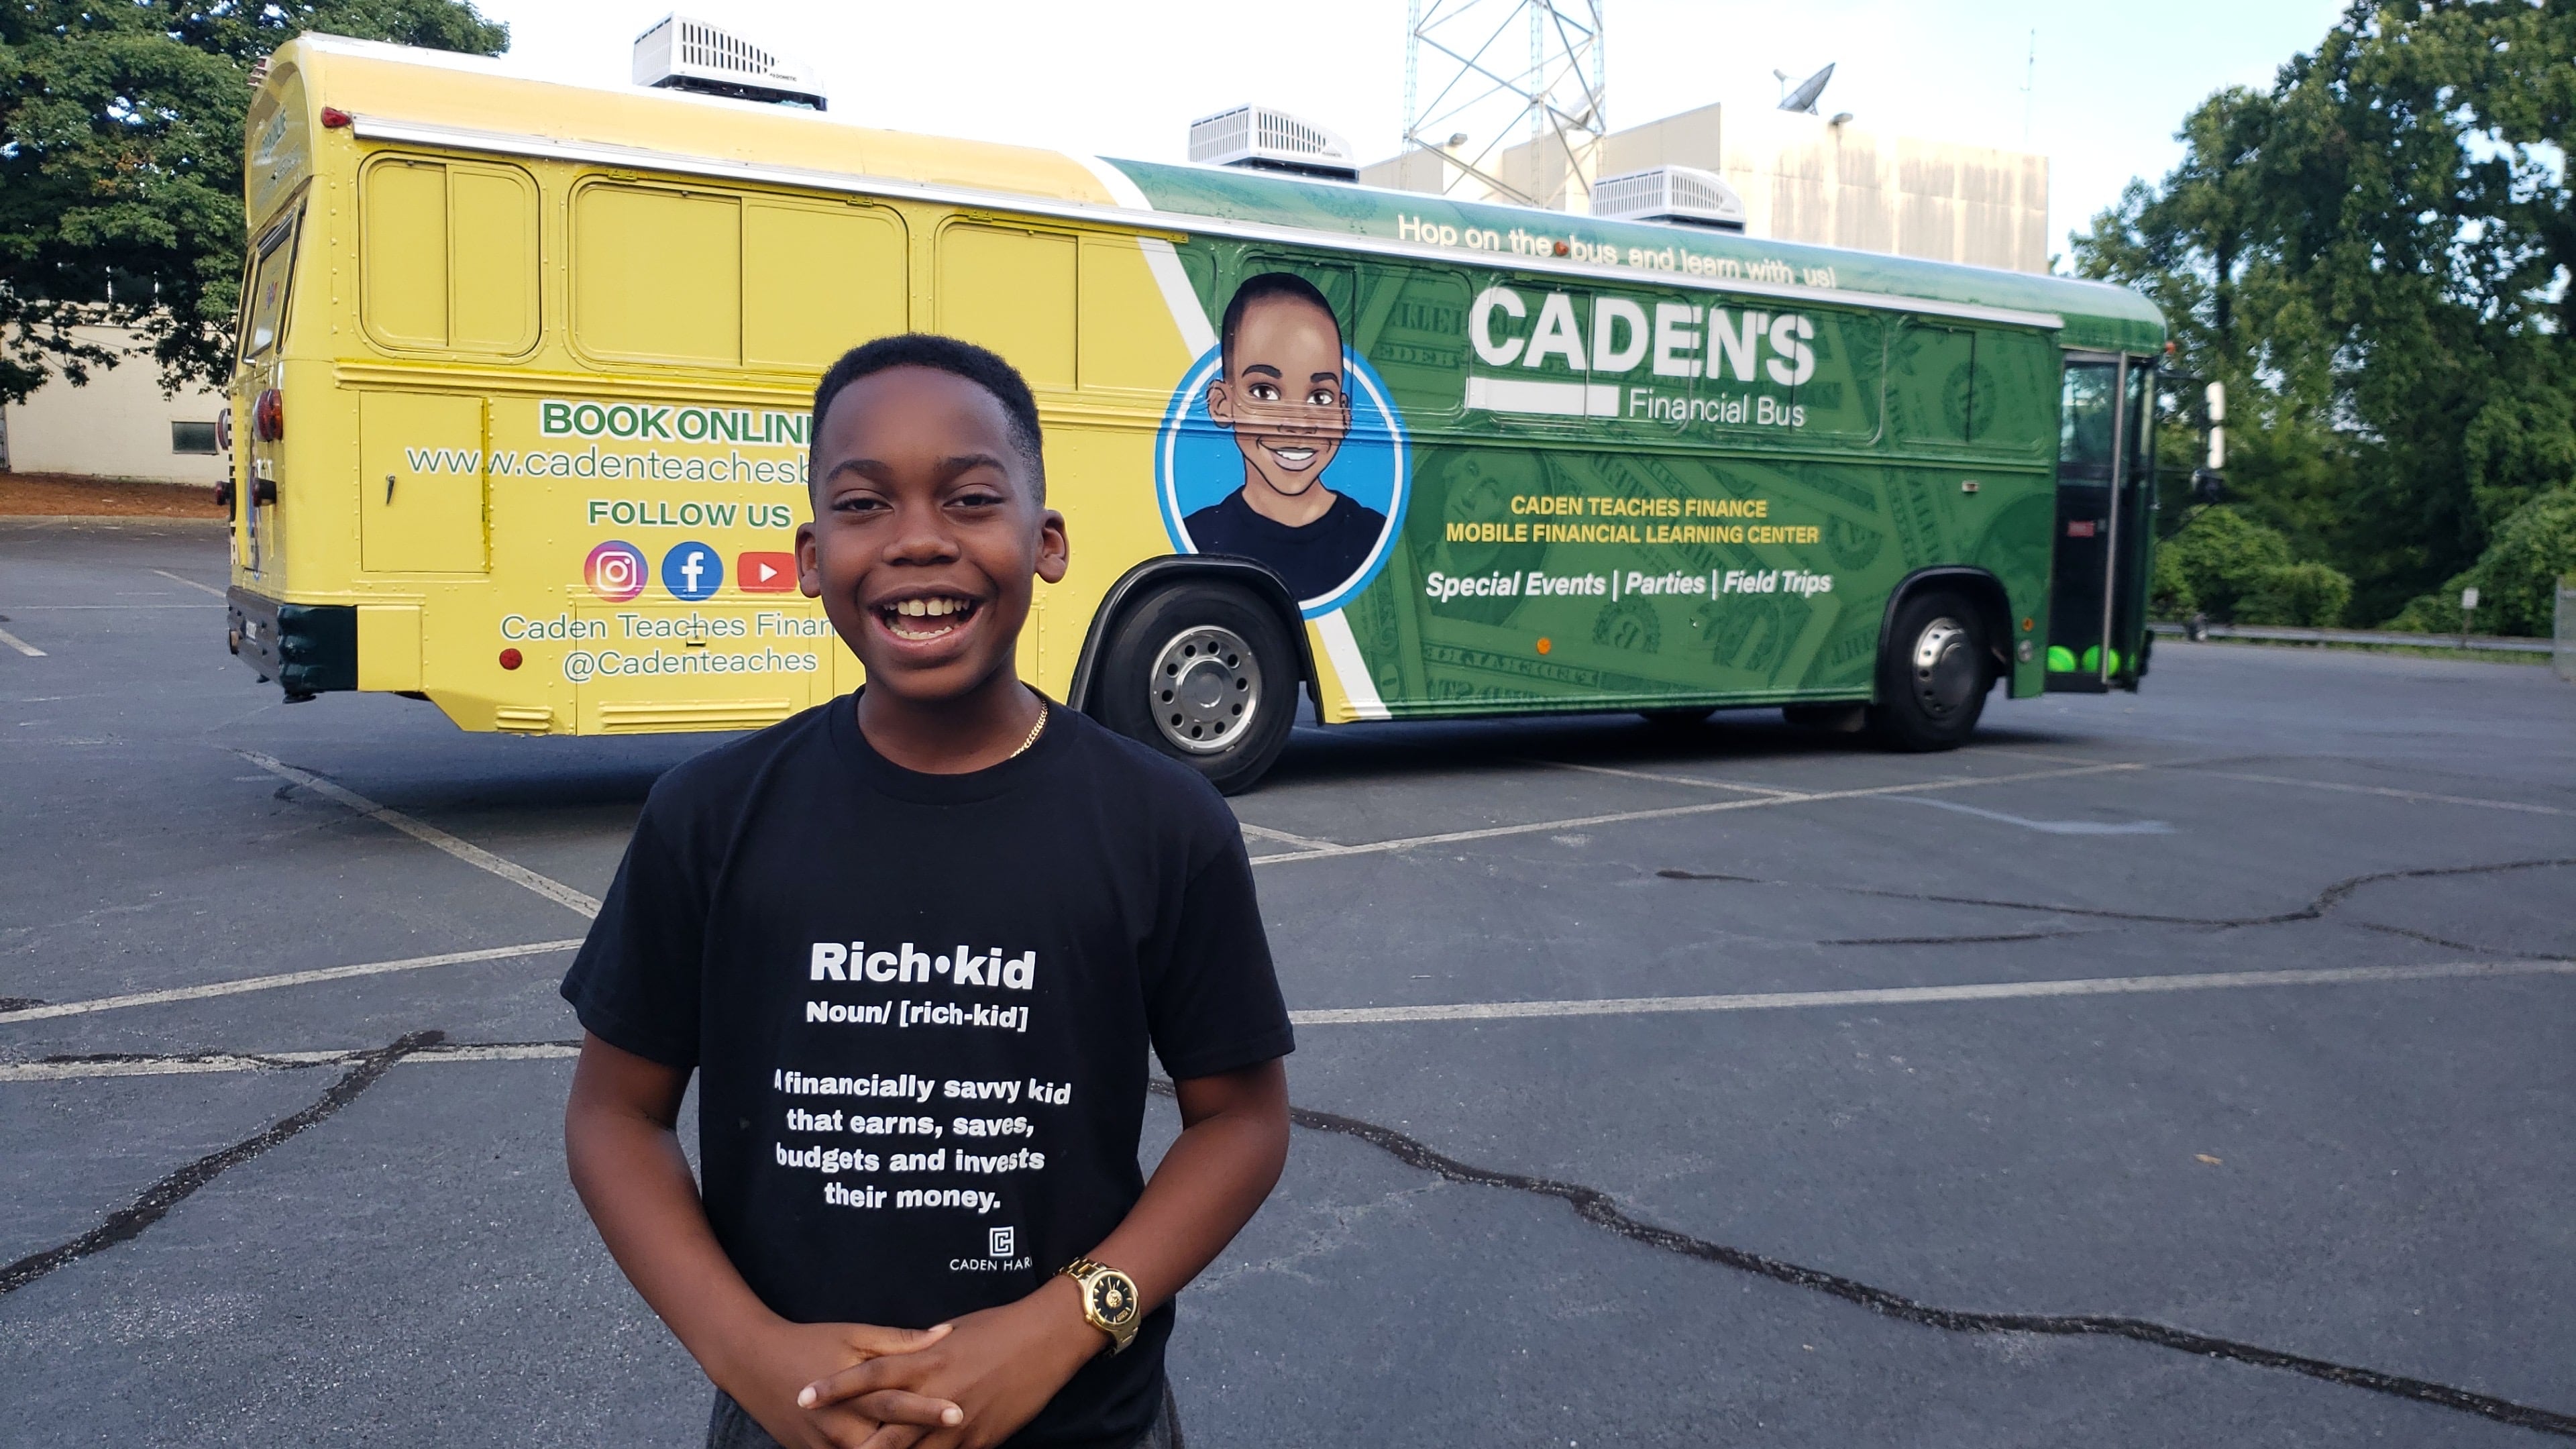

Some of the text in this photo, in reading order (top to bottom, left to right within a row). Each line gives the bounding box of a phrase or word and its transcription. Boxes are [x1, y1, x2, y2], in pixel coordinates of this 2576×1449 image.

[1398, 214, 1837, 288] Hop on the bus and learn with us!
[1469, 287, 1815, 386] CADEN'S
[542, 402, 671, 437] BOOK
[1629, 388, 1804, 426] Financial Bus
[589, 501, 792, 528] FOLLOW US
[1511, 496, 1766, 517] CADEN TEACHES FINANCE
[1447, 523, 1818, 543] MOBILE FINANCIAL LEARNING CENTER
[1426, 571, 1521, 602] Special
[1525, 572, 1606, 595] Events
[1625, 570, 1706, 594] Parties
[1723, 570, 1778, 593] Field
[1782, 570, 1831, 598] Trips
[502, 614, 606, 640] Caden
[618, 612, 746, 637] Teaches
[564, 648, 817, 682] @Cadenteaches
[807, 1000, 1028, 1032] Noun/ [rich-kid]
[785, 1071, 935, 1102] financially
[944, 1080, 1021, 1104] savvy
[1028, 1078, 1071, 1104] kid
[787, 1109, 1034, 1138] that earns, saves,
[776, 1142, 1044, 1173] budgets and invests
[824, 1182, 1000, 1214] their money.
[950, 1256, 1032, 1271] CADEN HAR
